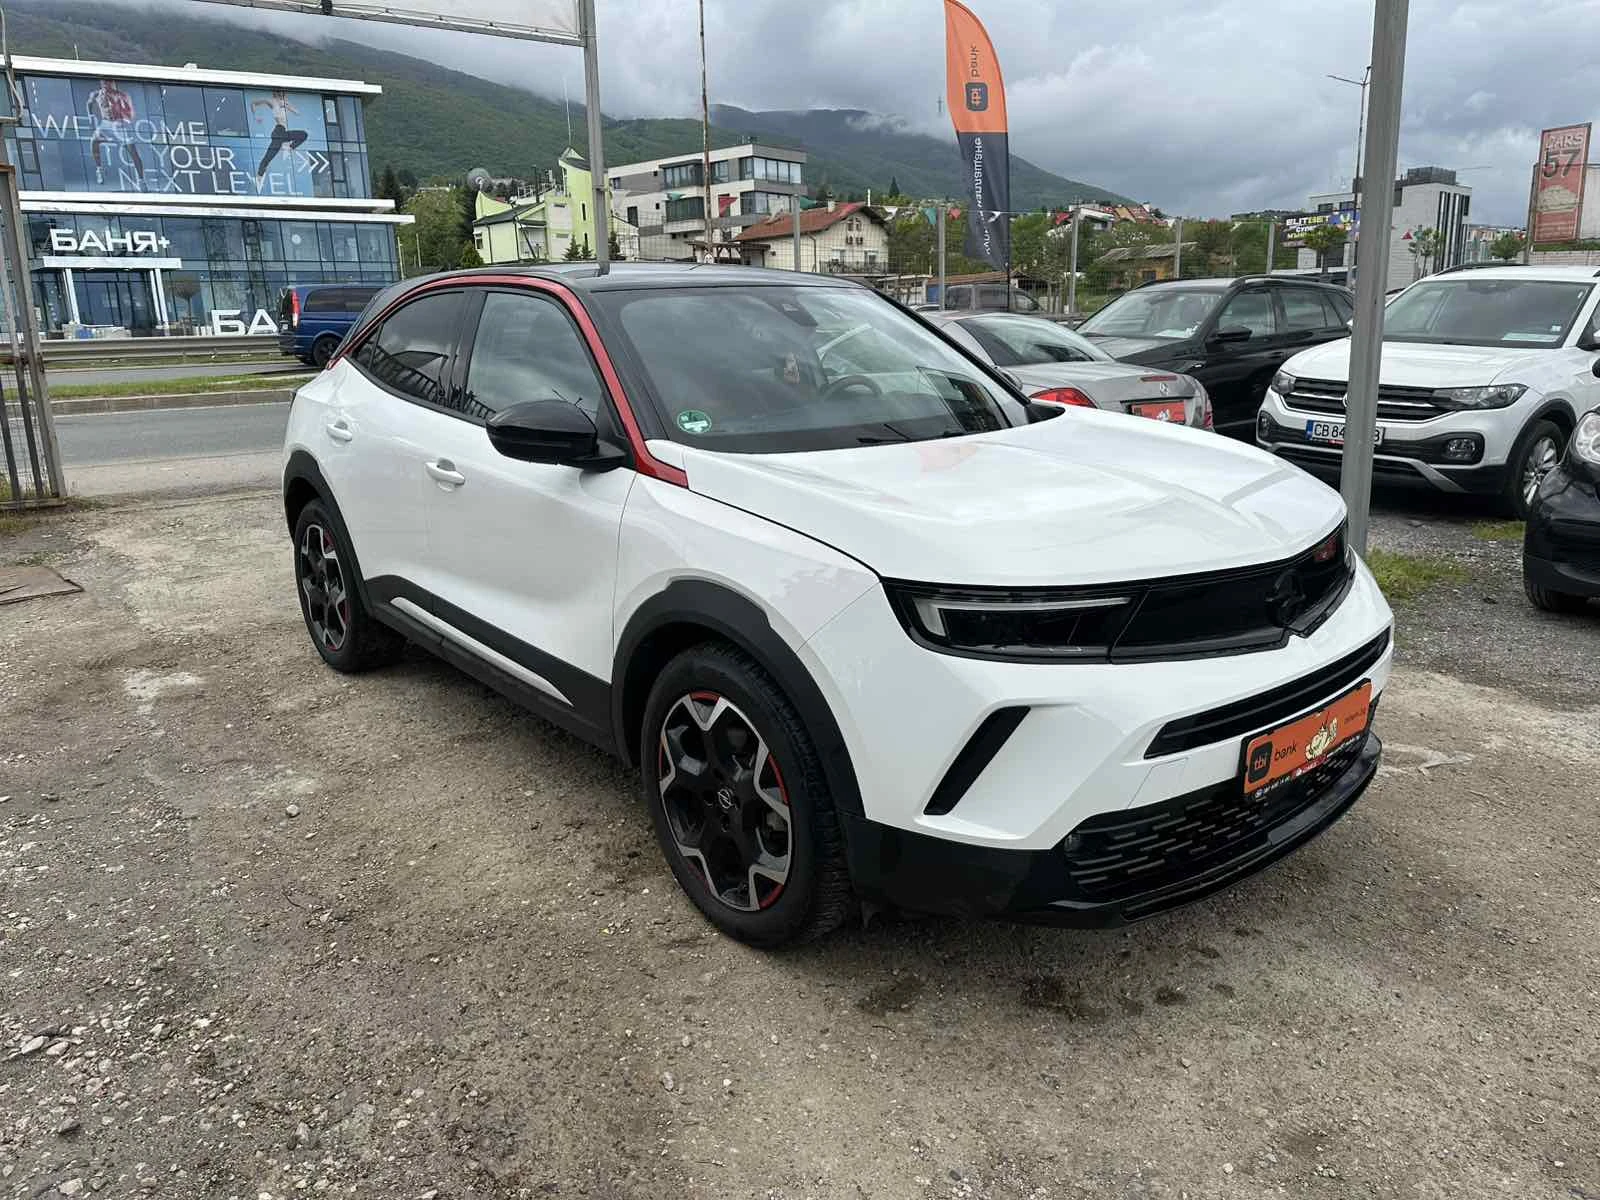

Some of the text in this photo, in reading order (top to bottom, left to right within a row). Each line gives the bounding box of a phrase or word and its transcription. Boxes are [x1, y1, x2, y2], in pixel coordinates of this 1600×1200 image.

[151, 145, 236, 170] YOUR
[1543, 147, 1581, 178] 57
[118, 167, 303, 196] NEXT LEVEL
[211, 308, 280, 336] БА
